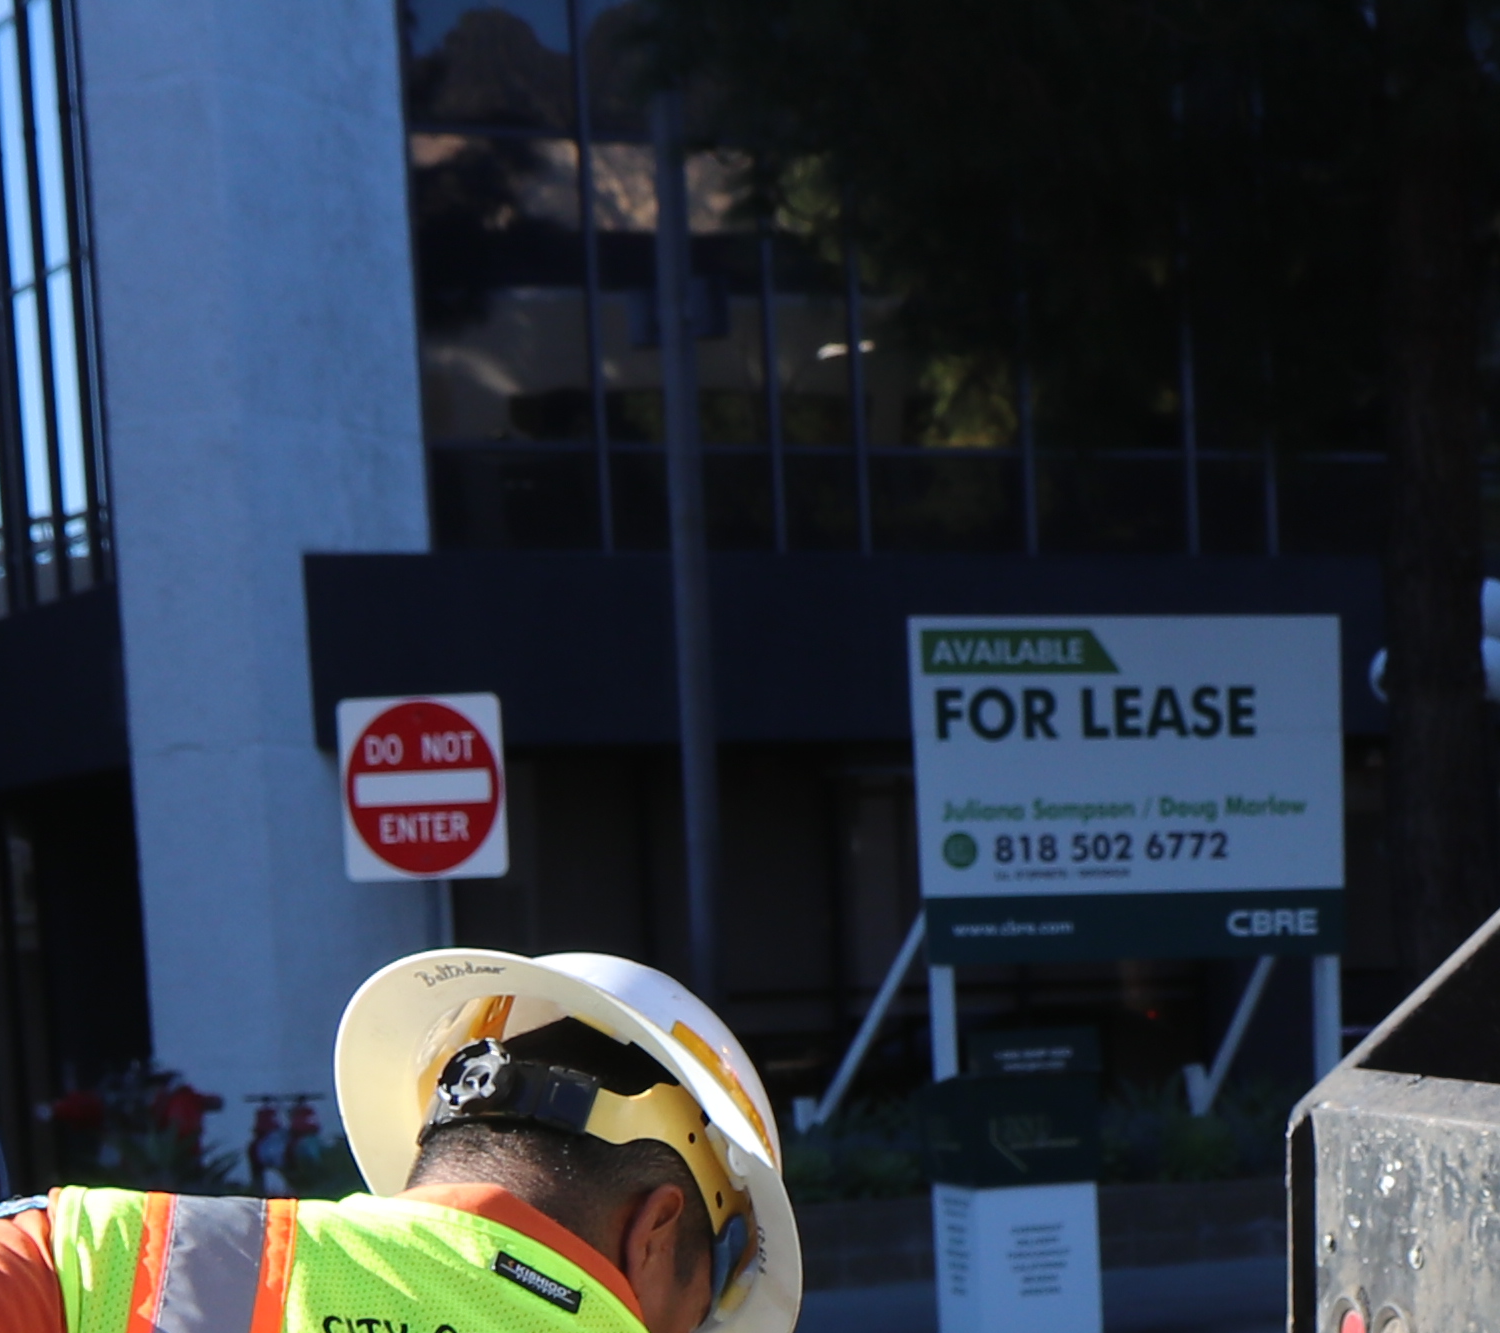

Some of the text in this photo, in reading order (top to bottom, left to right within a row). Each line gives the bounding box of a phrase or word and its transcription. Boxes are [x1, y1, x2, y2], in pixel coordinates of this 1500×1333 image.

[931, 637, 1086, 665] AVAILABLE
[934, 685, 1257, 742] FOR LEASE
[364, 731, 475, 766] DO NOT
[1158, 796, 1218, 821] Doug
[378, 810, 471, 845] ENTER
[993, 831, 1230, 863] 818 502 6772
[1226, 907, 1320, 938] CBRE
[514, 1263, 572, 1298] KISHIGO
